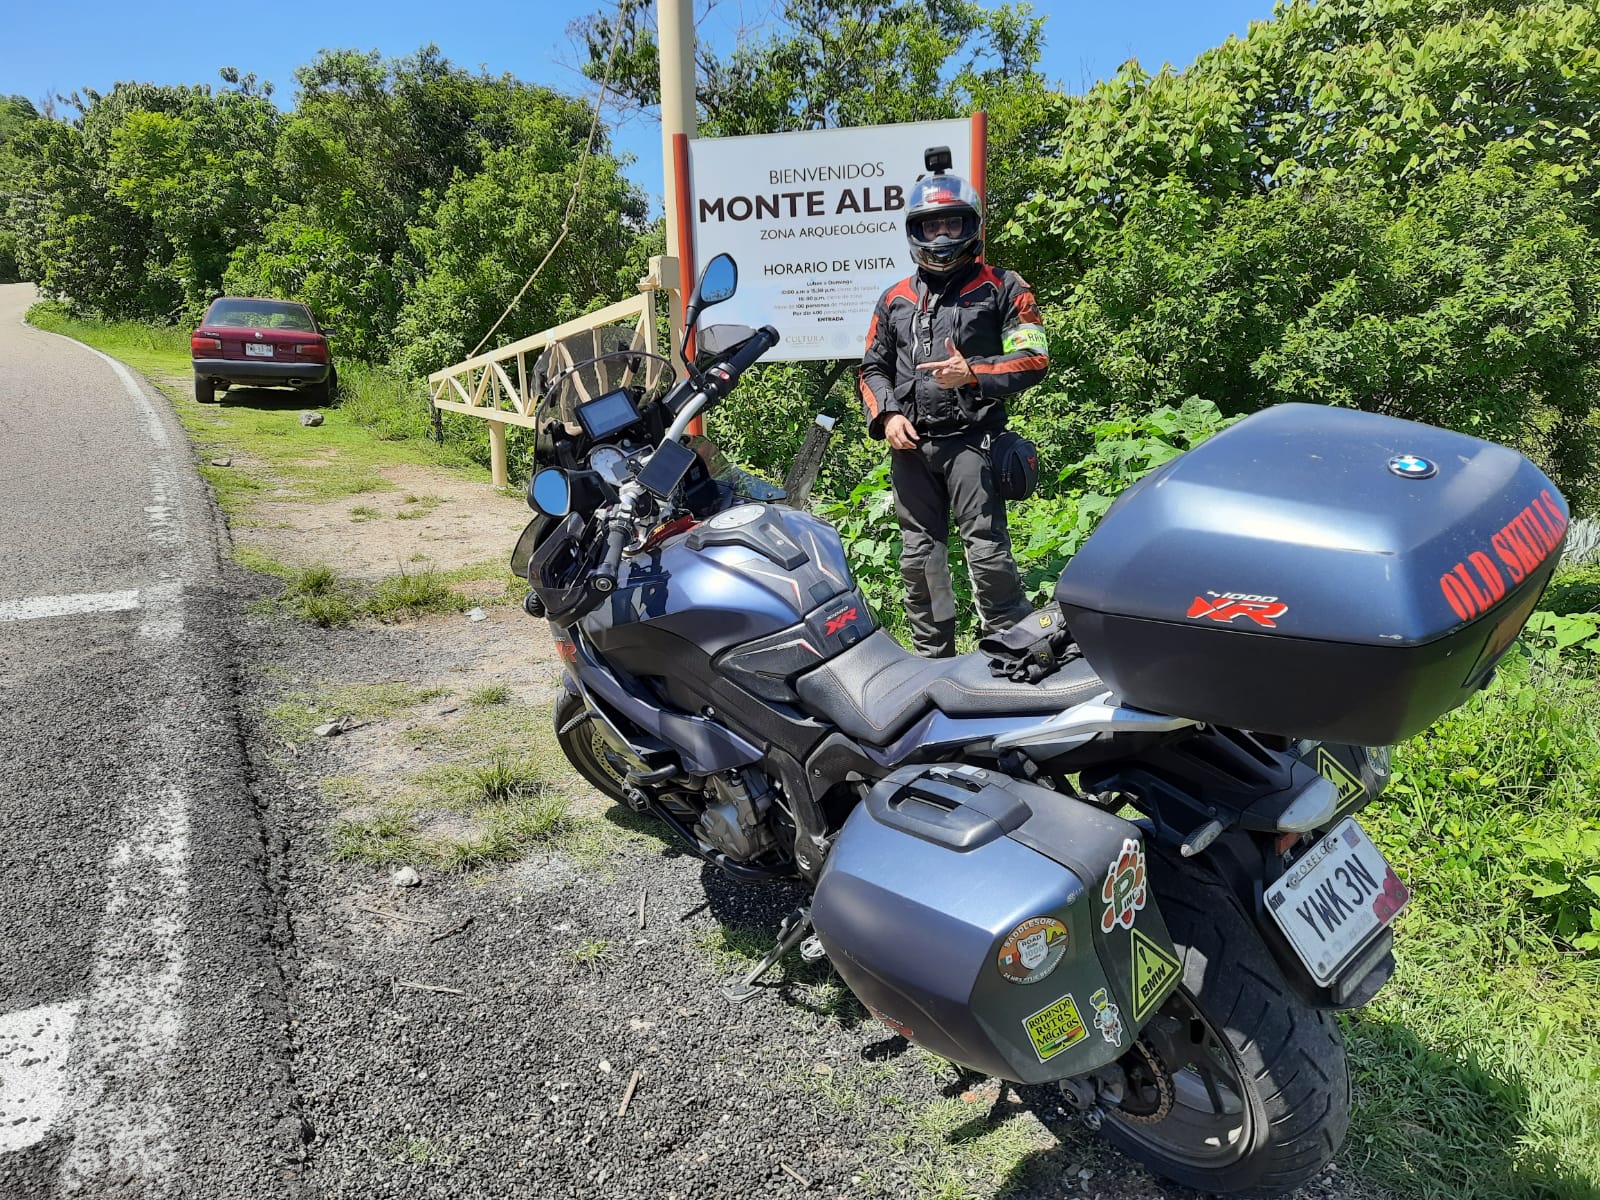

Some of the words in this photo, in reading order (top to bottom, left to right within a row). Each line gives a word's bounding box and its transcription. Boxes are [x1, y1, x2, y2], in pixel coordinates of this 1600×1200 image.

[769, 161, 885, 184] BIENVENIDOS
[699, 190, 825, 223] MONTE
[835, 184, 906, 215] ALB
[760, 227, 796, 240] ZONA
[799, 220, 897, 239] ARQUEOLÓGICA
[764, 261, 828, 276] HORARIO
[832, 260, 851, 272] DE
[854, 257, 896, 270] VISITA
[785, 335, 825, 344] CULTURA
[1439, 550, 1506, 621] OLD
[1491, 489, 1568, 584] SKULLS
[1186, 596, 1289, 628] XR
[1295, 853, 1379, 942] YWK3N
[1003, 917, 1057, 949] SADDLESORE
[1021, 934, 1042, 947] ROAD
[1140, 963, 1166, 999] BMW
